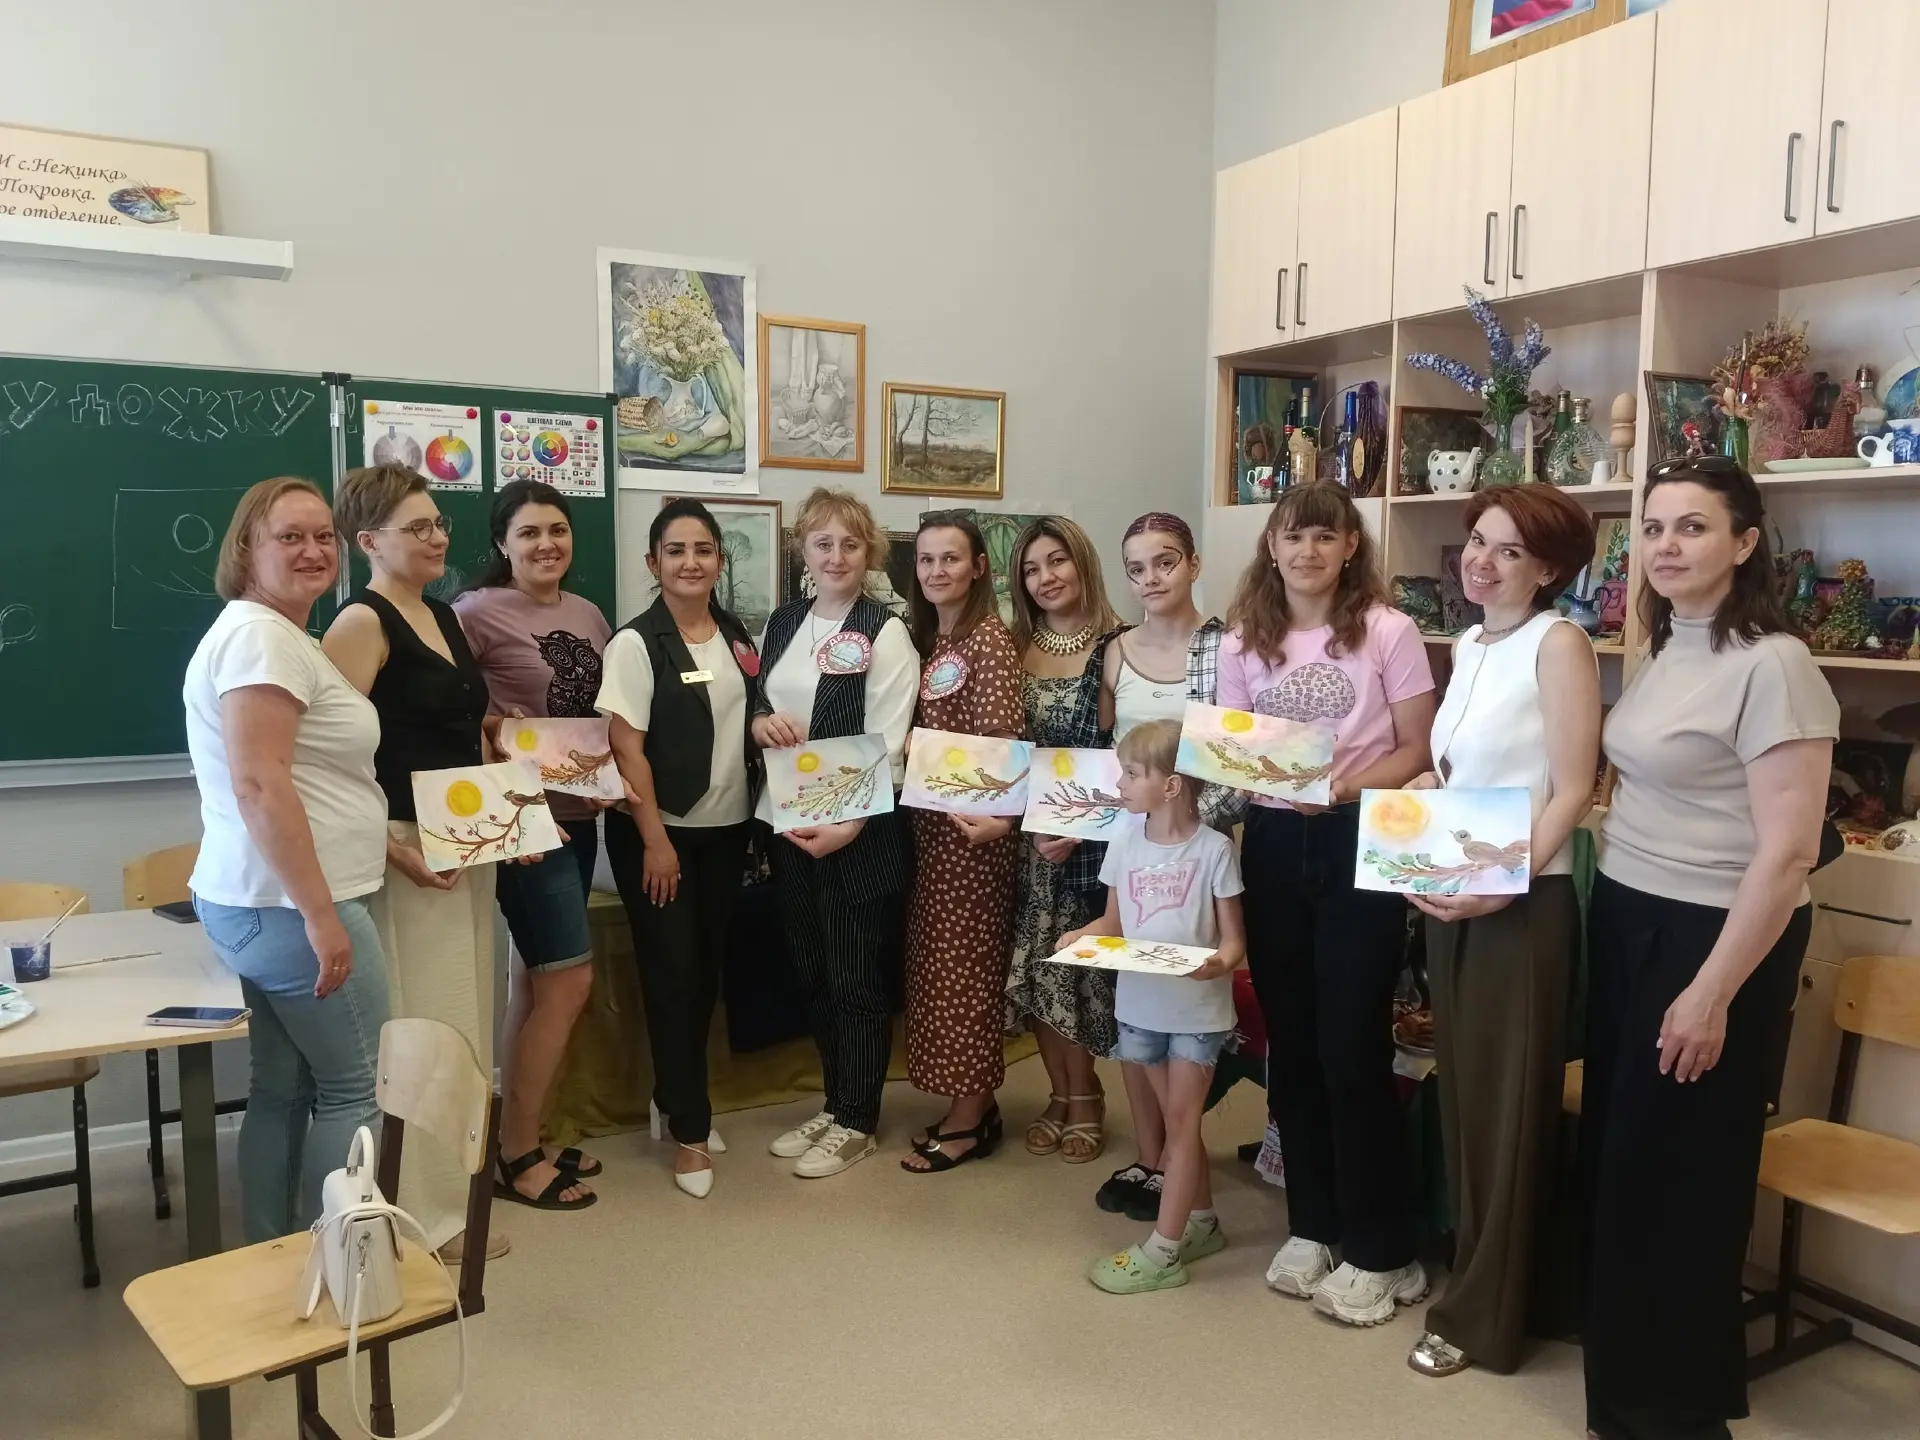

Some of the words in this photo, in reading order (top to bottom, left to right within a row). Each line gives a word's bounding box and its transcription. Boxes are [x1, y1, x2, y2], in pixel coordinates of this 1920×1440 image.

[0, 177, 95, 204] Покровка.
[23, 204, 121, 225] отделение.
[829, 633, 870, 659] ДРУЖНЫЕ
[924, 654, 965, 680] ДРУЖНЫЕ
